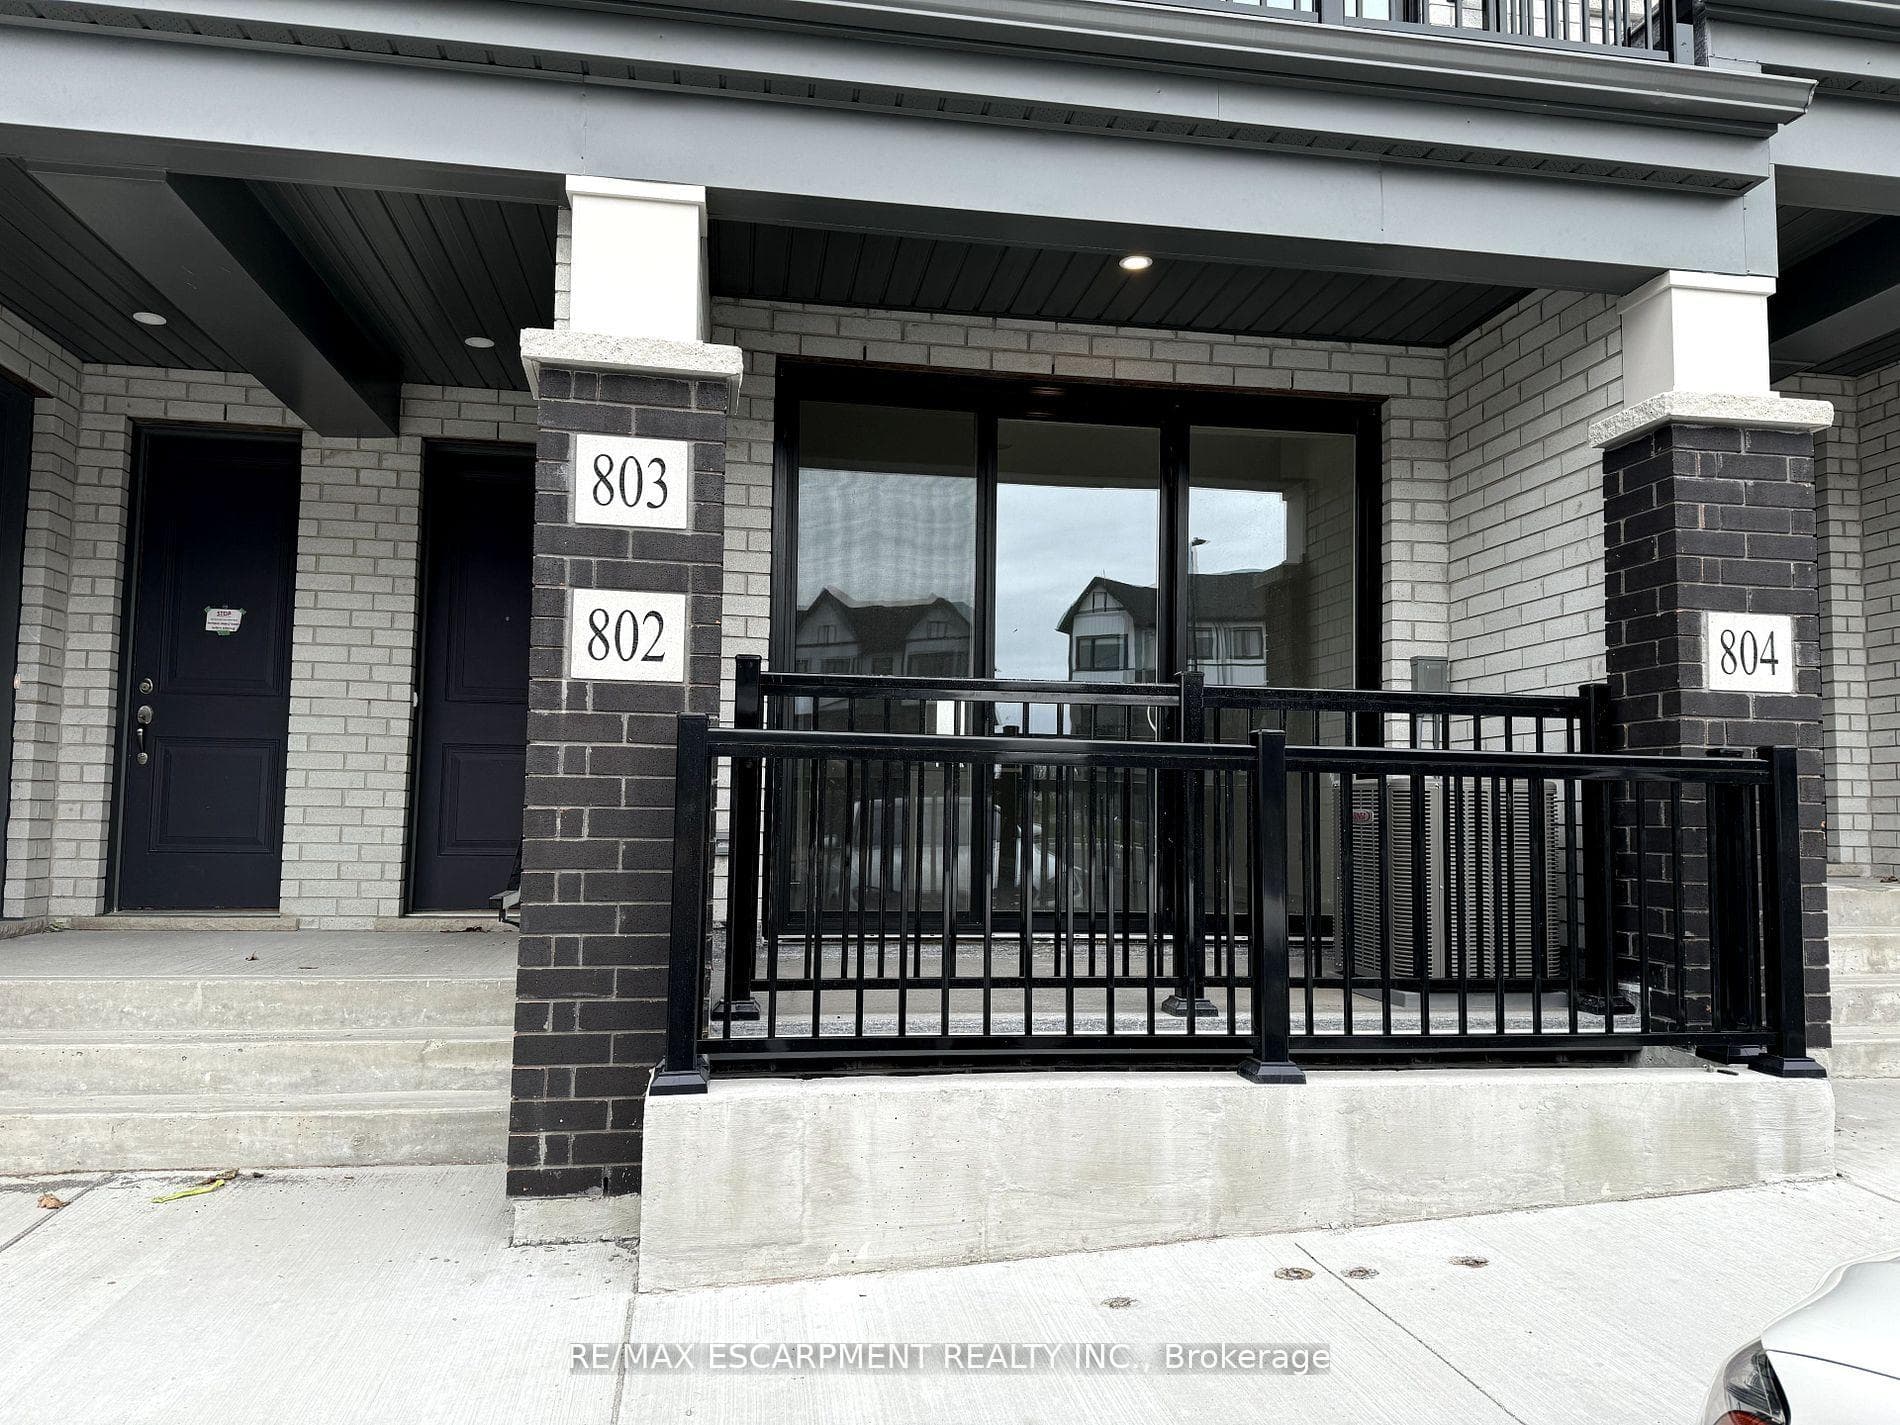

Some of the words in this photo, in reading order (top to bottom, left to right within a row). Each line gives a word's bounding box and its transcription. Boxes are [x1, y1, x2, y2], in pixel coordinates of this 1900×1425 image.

[592, 453, 668, 509] 803
[587, 608, 666, 662] 802
[1720, 629, 1779, 676] 804
